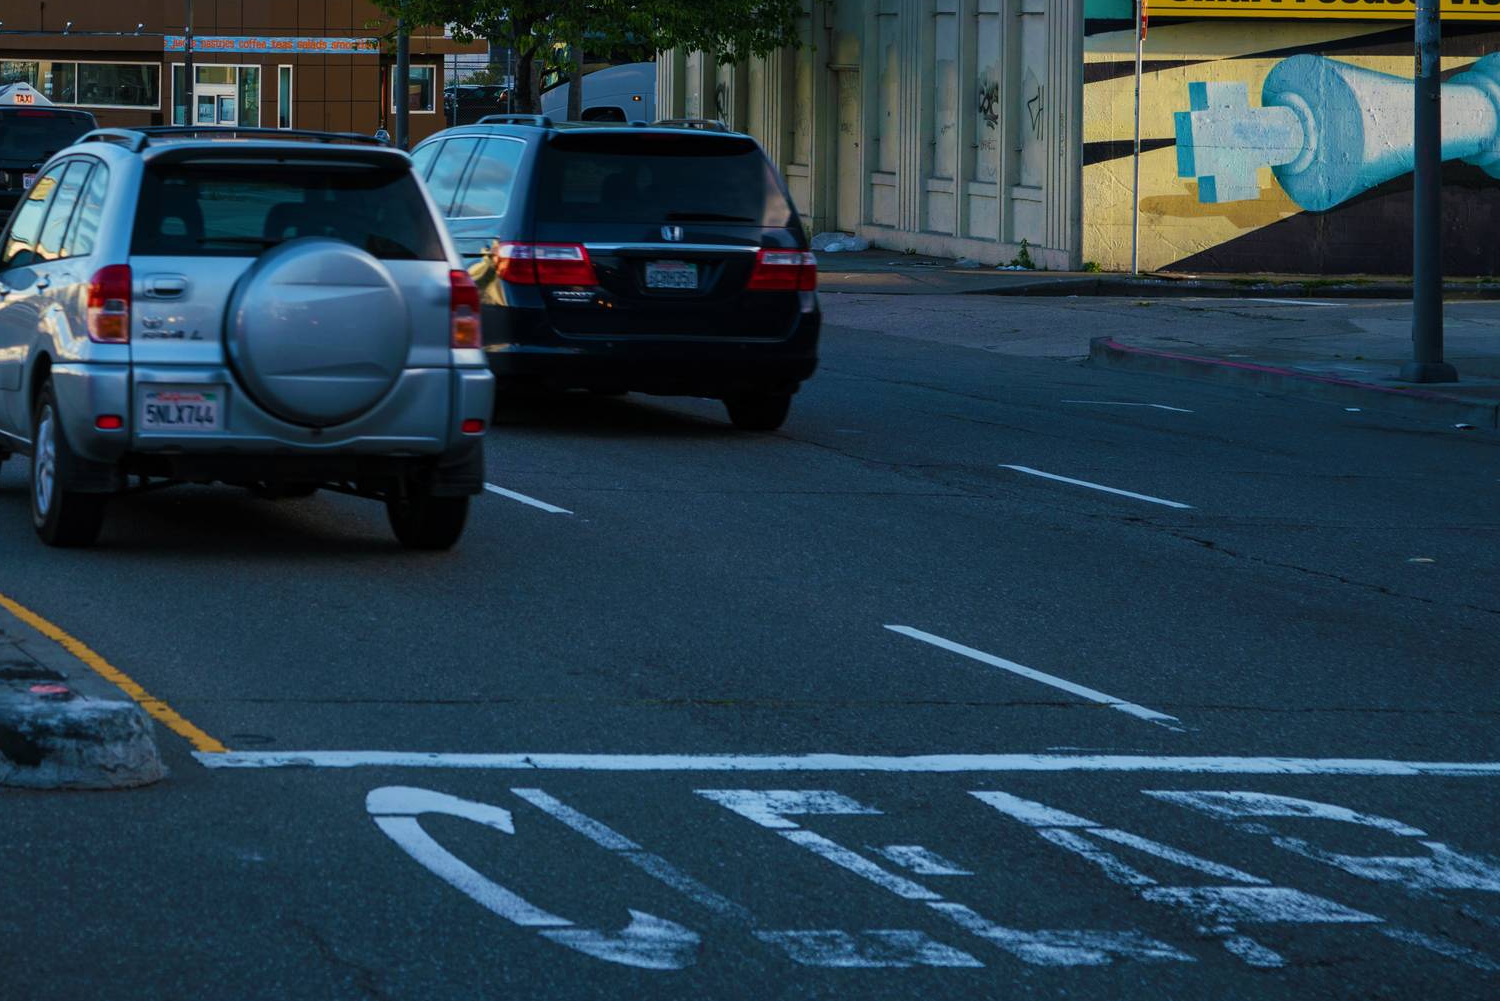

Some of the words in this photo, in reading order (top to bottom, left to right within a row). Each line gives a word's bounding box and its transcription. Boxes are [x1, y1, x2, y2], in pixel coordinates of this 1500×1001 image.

[238, 39, 266, 49] coffee
[297, 39, 328, 49] salads
[15, 94, 33, 104] TAXI
[146, 404, 214, 423] 5NLX744
